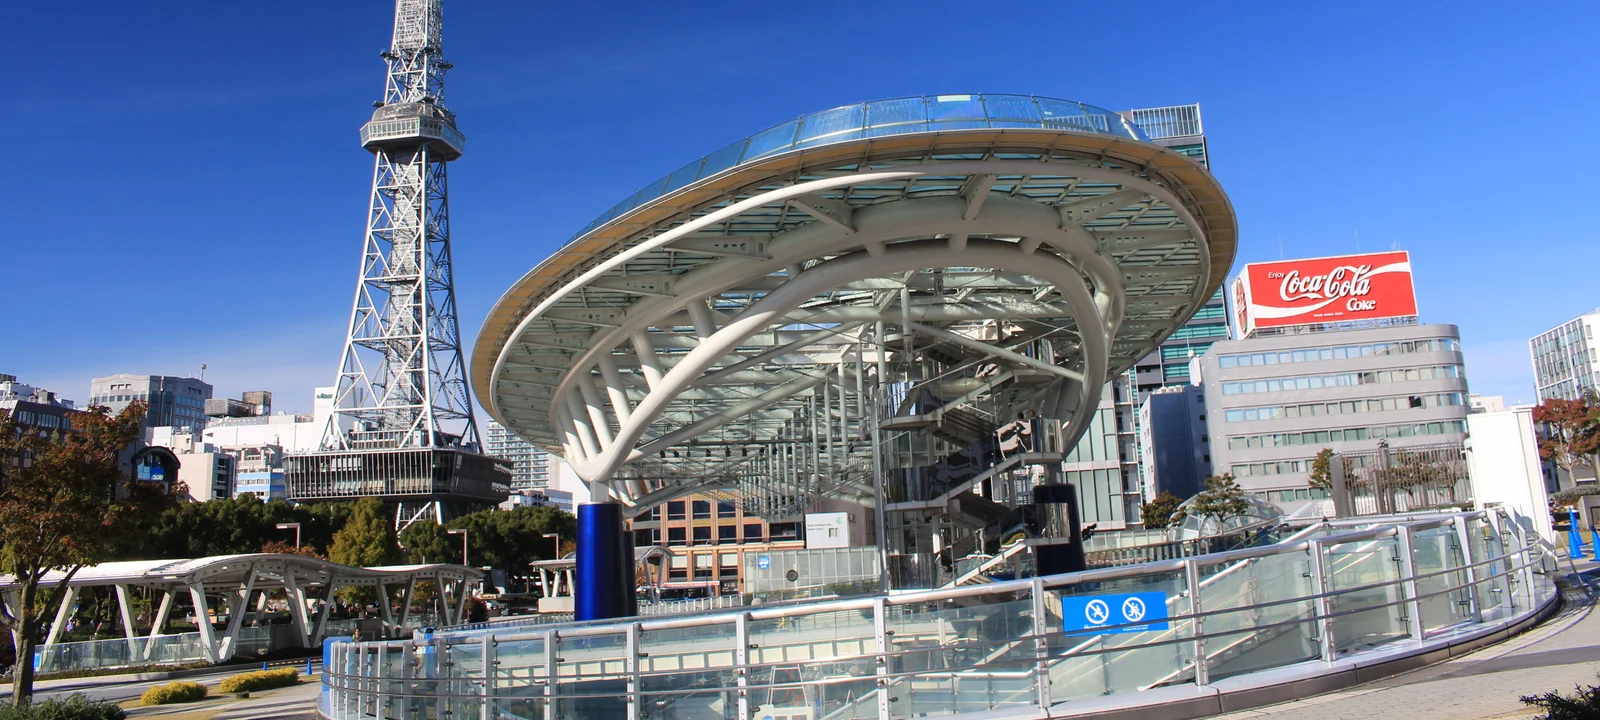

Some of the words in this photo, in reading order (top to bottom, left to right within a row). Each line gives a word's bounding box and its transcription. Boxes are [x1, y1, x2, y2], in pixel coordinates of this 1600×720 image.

[1268, 271, 1285, 279] Enjoy
[1280, 264, 1371, 301] Coca-Cola
[1346, 297, 1376, 312] Coke
